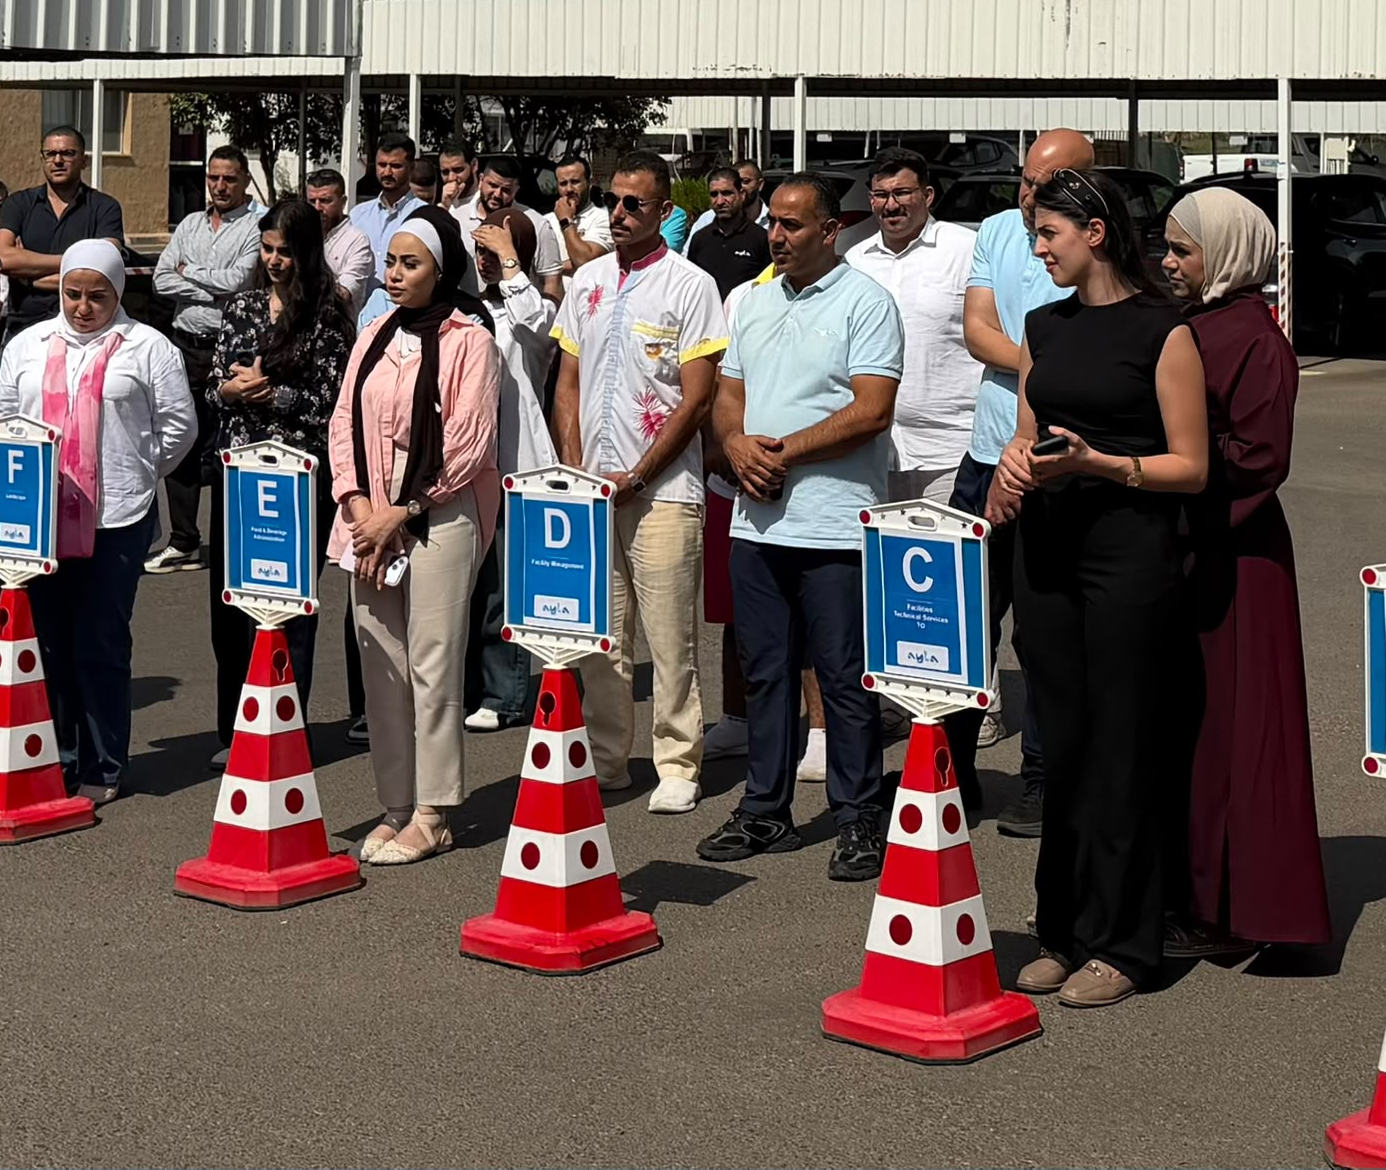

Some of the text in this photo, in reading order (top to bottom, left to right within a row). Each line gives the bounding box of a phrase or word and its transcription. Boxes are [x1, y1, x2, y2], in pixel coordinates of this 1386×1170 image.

[7, 449, 24, 483] F
[257, 479, 279, 518] E
[543, 507, 571, 549] D
[902, 546, 934, 593] C
[893, 610, 949, 624] Technical Services
[906, 603, 933, 613] Facilities
[907, 650, 939, 664] ayla
